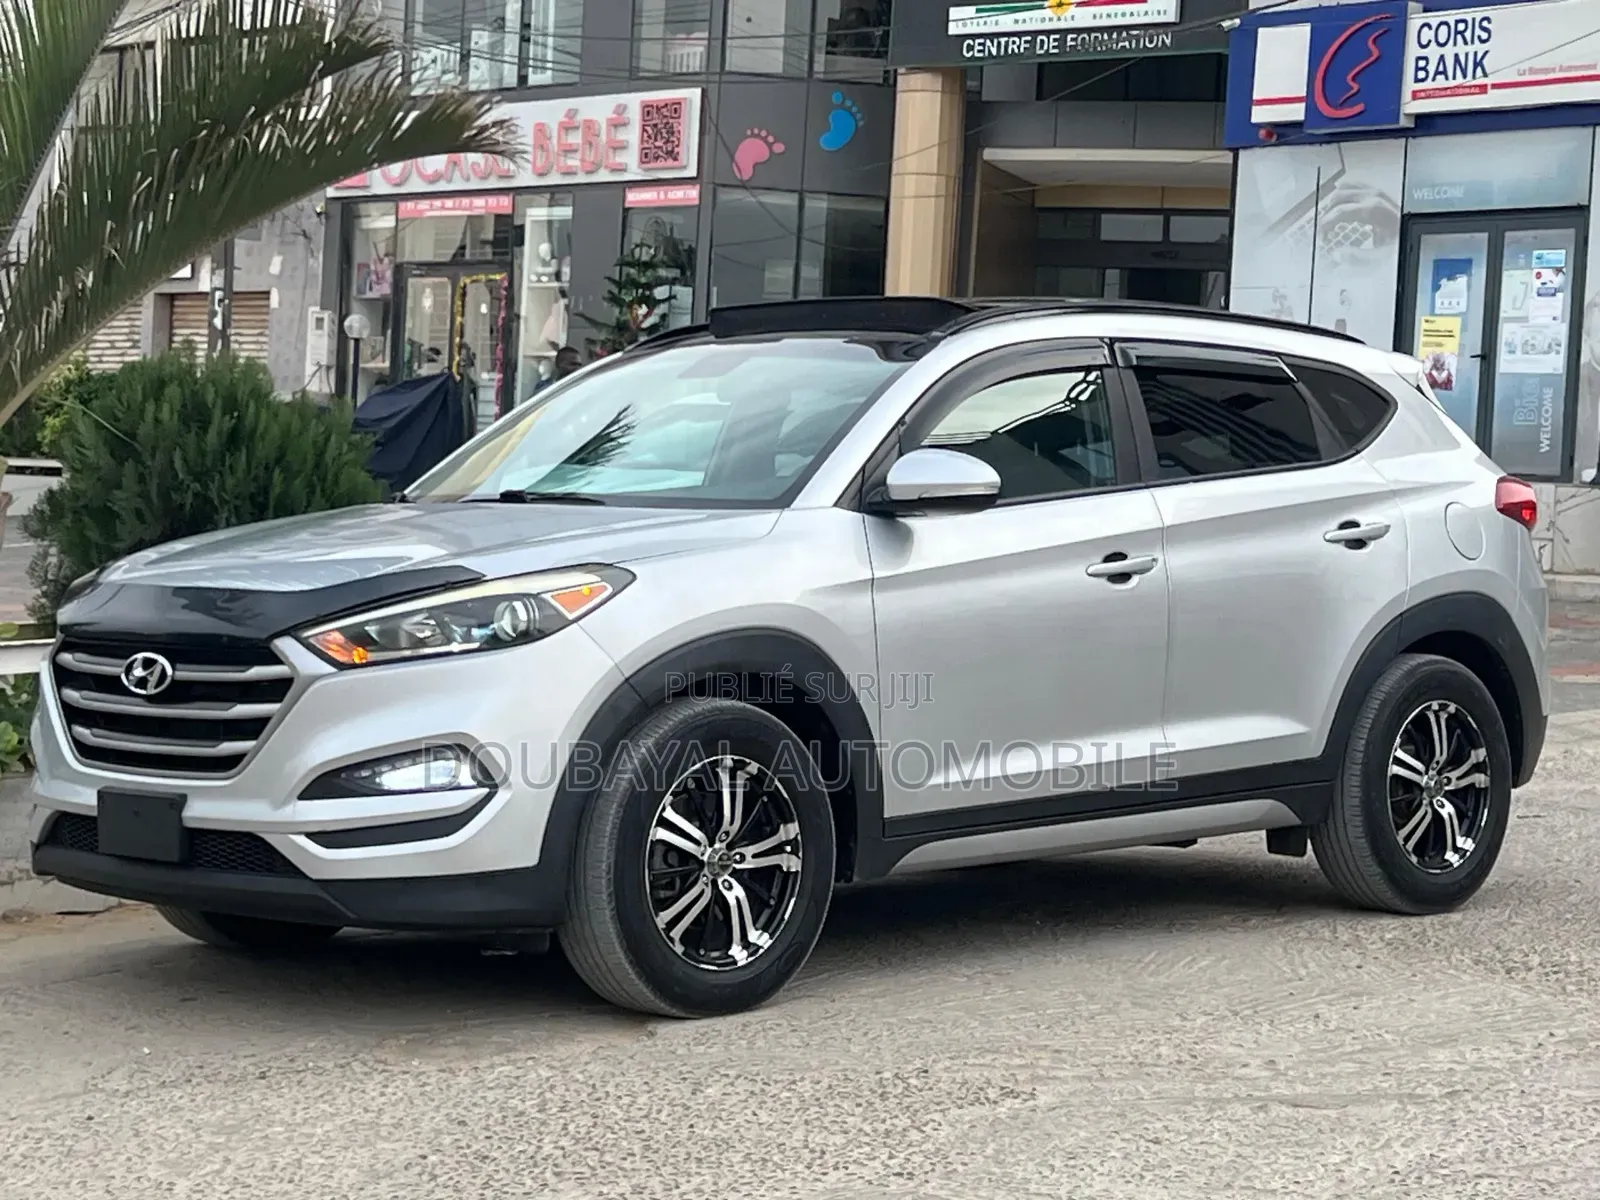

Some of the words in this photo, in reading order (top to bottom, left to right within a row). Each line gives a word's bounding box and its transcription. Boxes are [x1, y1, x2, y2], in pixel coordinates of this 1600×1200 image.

[1012, 15, 1076, 26] NATIONALE
[1416, 16, 1492, 49] CORIS
[962, 35, 1032, 58] CENTRE
[1036, 34, 1061, 55] DE
[1066, 29, 1172, 52] FORMATION
[1413, 50, 1490, 84] BANK
[531, 103, 631, 177] BÉBÉ
[1412, 184, 1465, 201] WELCOME
[1539, 387, 1554, 453] WELCOME
